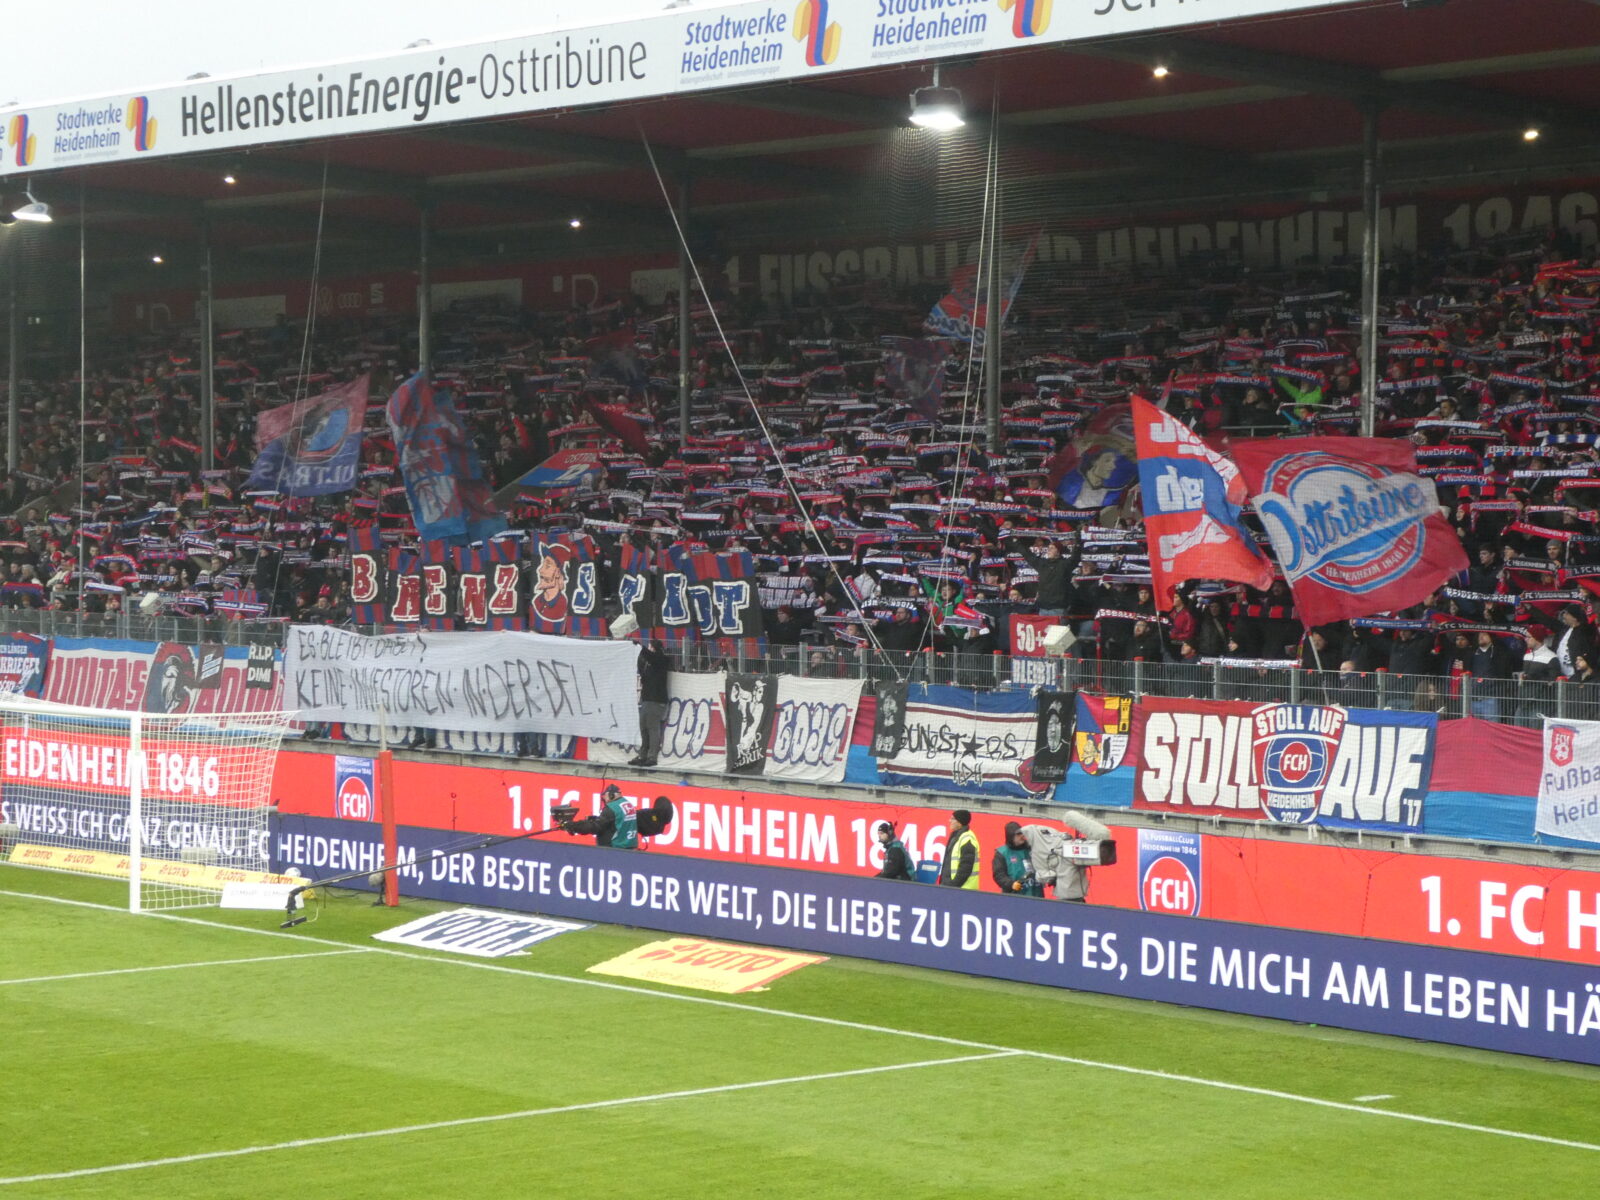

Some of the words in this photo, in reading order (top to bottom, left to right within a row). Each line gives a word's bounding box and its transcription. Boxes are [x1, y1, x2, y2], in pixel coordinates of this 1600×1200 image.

[684, 8, 787, 46] Stadtwerke
[872, 12, 987, 47] Heidenheim
[681, 40, 783, 73] Heidenheim
[56, 104, 122, 131] Stadtwerke
[53, 129, 120, 153] Heidenheim
[248, 645, 274, 661] R.I.P.
[247, 667, 272, 683] DIMI
[295, 667, 348, 710] KEINE
[484, 658, 541, 720] DER
[1255, 706, 1304, 737] STOLL
[1308, 708, 1344, 736] AUF
[156, 752, 220, 797] 1846
[1141, 712, 1260, 809] STOLL
[1319, 724, 1428, 823] AUF
[1282, 754, 1308, 773] FCH
[342, 792, 367, 818] FCH
[509, 785, 533, 831] 1.
[1150, 876, 1189, 910] FCH
[15, 802, 67, 835] WEISS
[73, 809, 102, 841] ICH
[108, 813, 162, 848] GANZ
[248, 828, 271, 860] FC
[431, 849, 476, 885] DER
[483, 855, 551, 896] BESTE
[558, 863, 622, 904] CLUB
[631, 873, 680, 912] DER
[688, 879, 763, 930] WELT,
[772, 889, 816, 930] DIE
[826, 896, 901, 942] LIEBE
[911, 907, 950, 948] ZU
[961, 913, 1014, 958] DIR
[1025, 921, 1072, 964] IST
[1082, 929, 1128, 982] ES,
[1141, 936, 1198, 983] DIE
[1209, 945, 1310, 999] MICH
[1322, 961, 1389, 1009] AM
[1403, 970, 1530, 1029] LEBEN
[1420, 875, 1461, 936] 1.
[1480, 880, 1544, 946] FC
